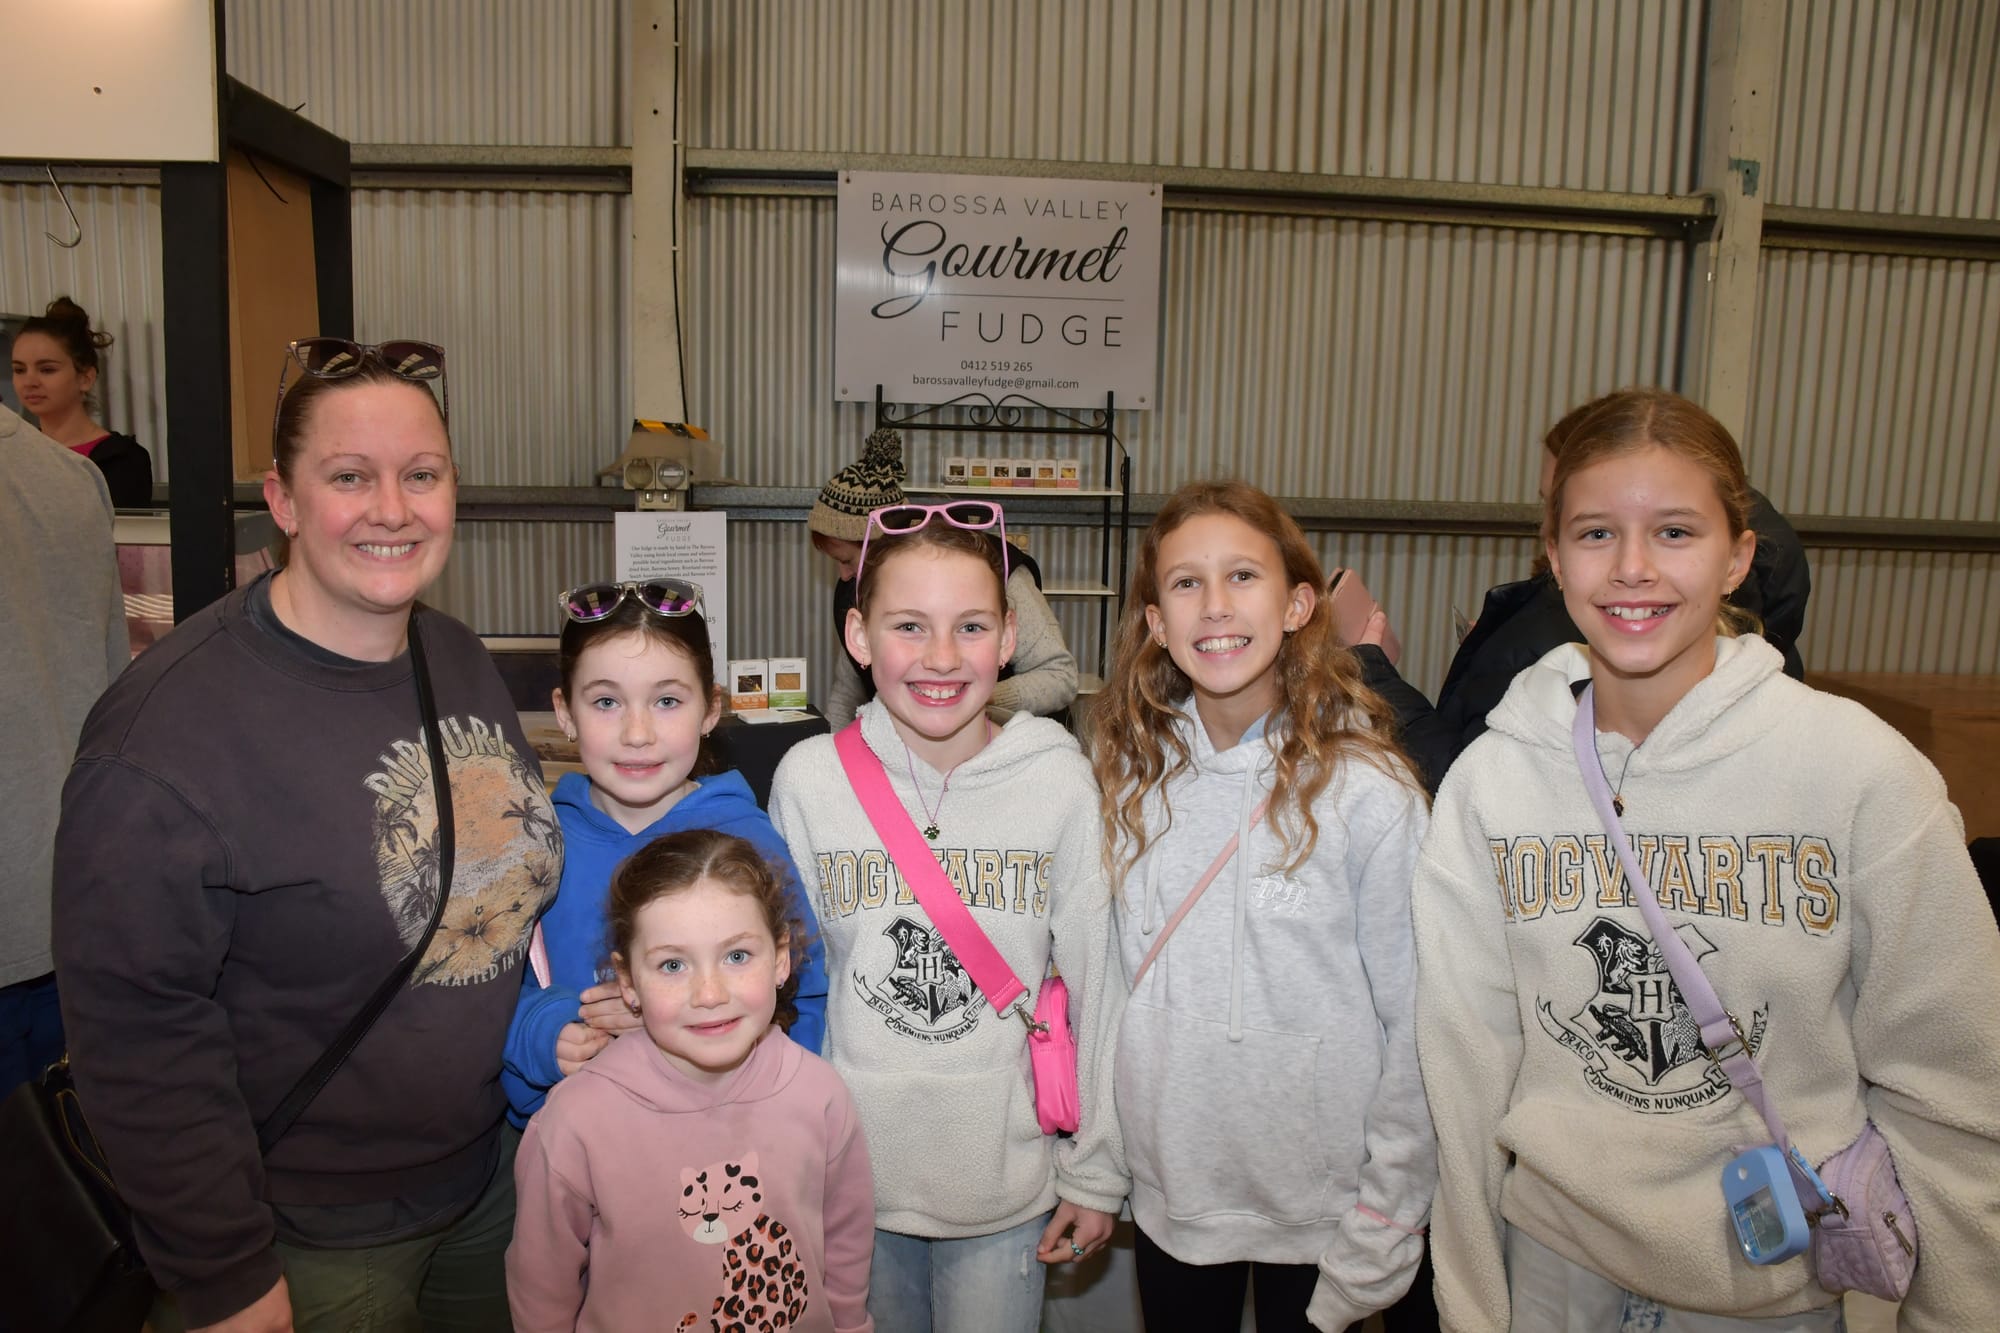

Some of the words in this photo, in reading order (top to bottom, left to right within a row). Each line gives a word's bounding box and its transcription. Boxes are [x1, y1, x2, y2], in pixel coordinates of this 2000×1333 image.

[872, 192, 1007, 216] BAROSSA
[1024, 198, 1129, 221] VALLEY
[871, 220, 1129, 319] Gourmet
[941, 310, 1124, 348] FUDGE
[960, 360, 988, 371] 0412
[990, 361, 1011, 372] 519
[1013, 362, 1034, 372] 265
[912, 374, 1080, 390] barossavalleyfudge@gmail.com
[363, 739, 428, 809] RIP
[503, 951, 515, 972] IN
[922, 955, 939, 981] H
[1638, 980, 1664, 1015] H
[893, 1021, 932, 1042] DORMIENS
[933, 1022, 973, 1042] NUNQUAM
[1559, 1031, 1595, 1061] DRACO
[1592, 1074, 1650, 1109] DORMIENS
[1654, 1085, 1717, 1110] NUNQUAM
